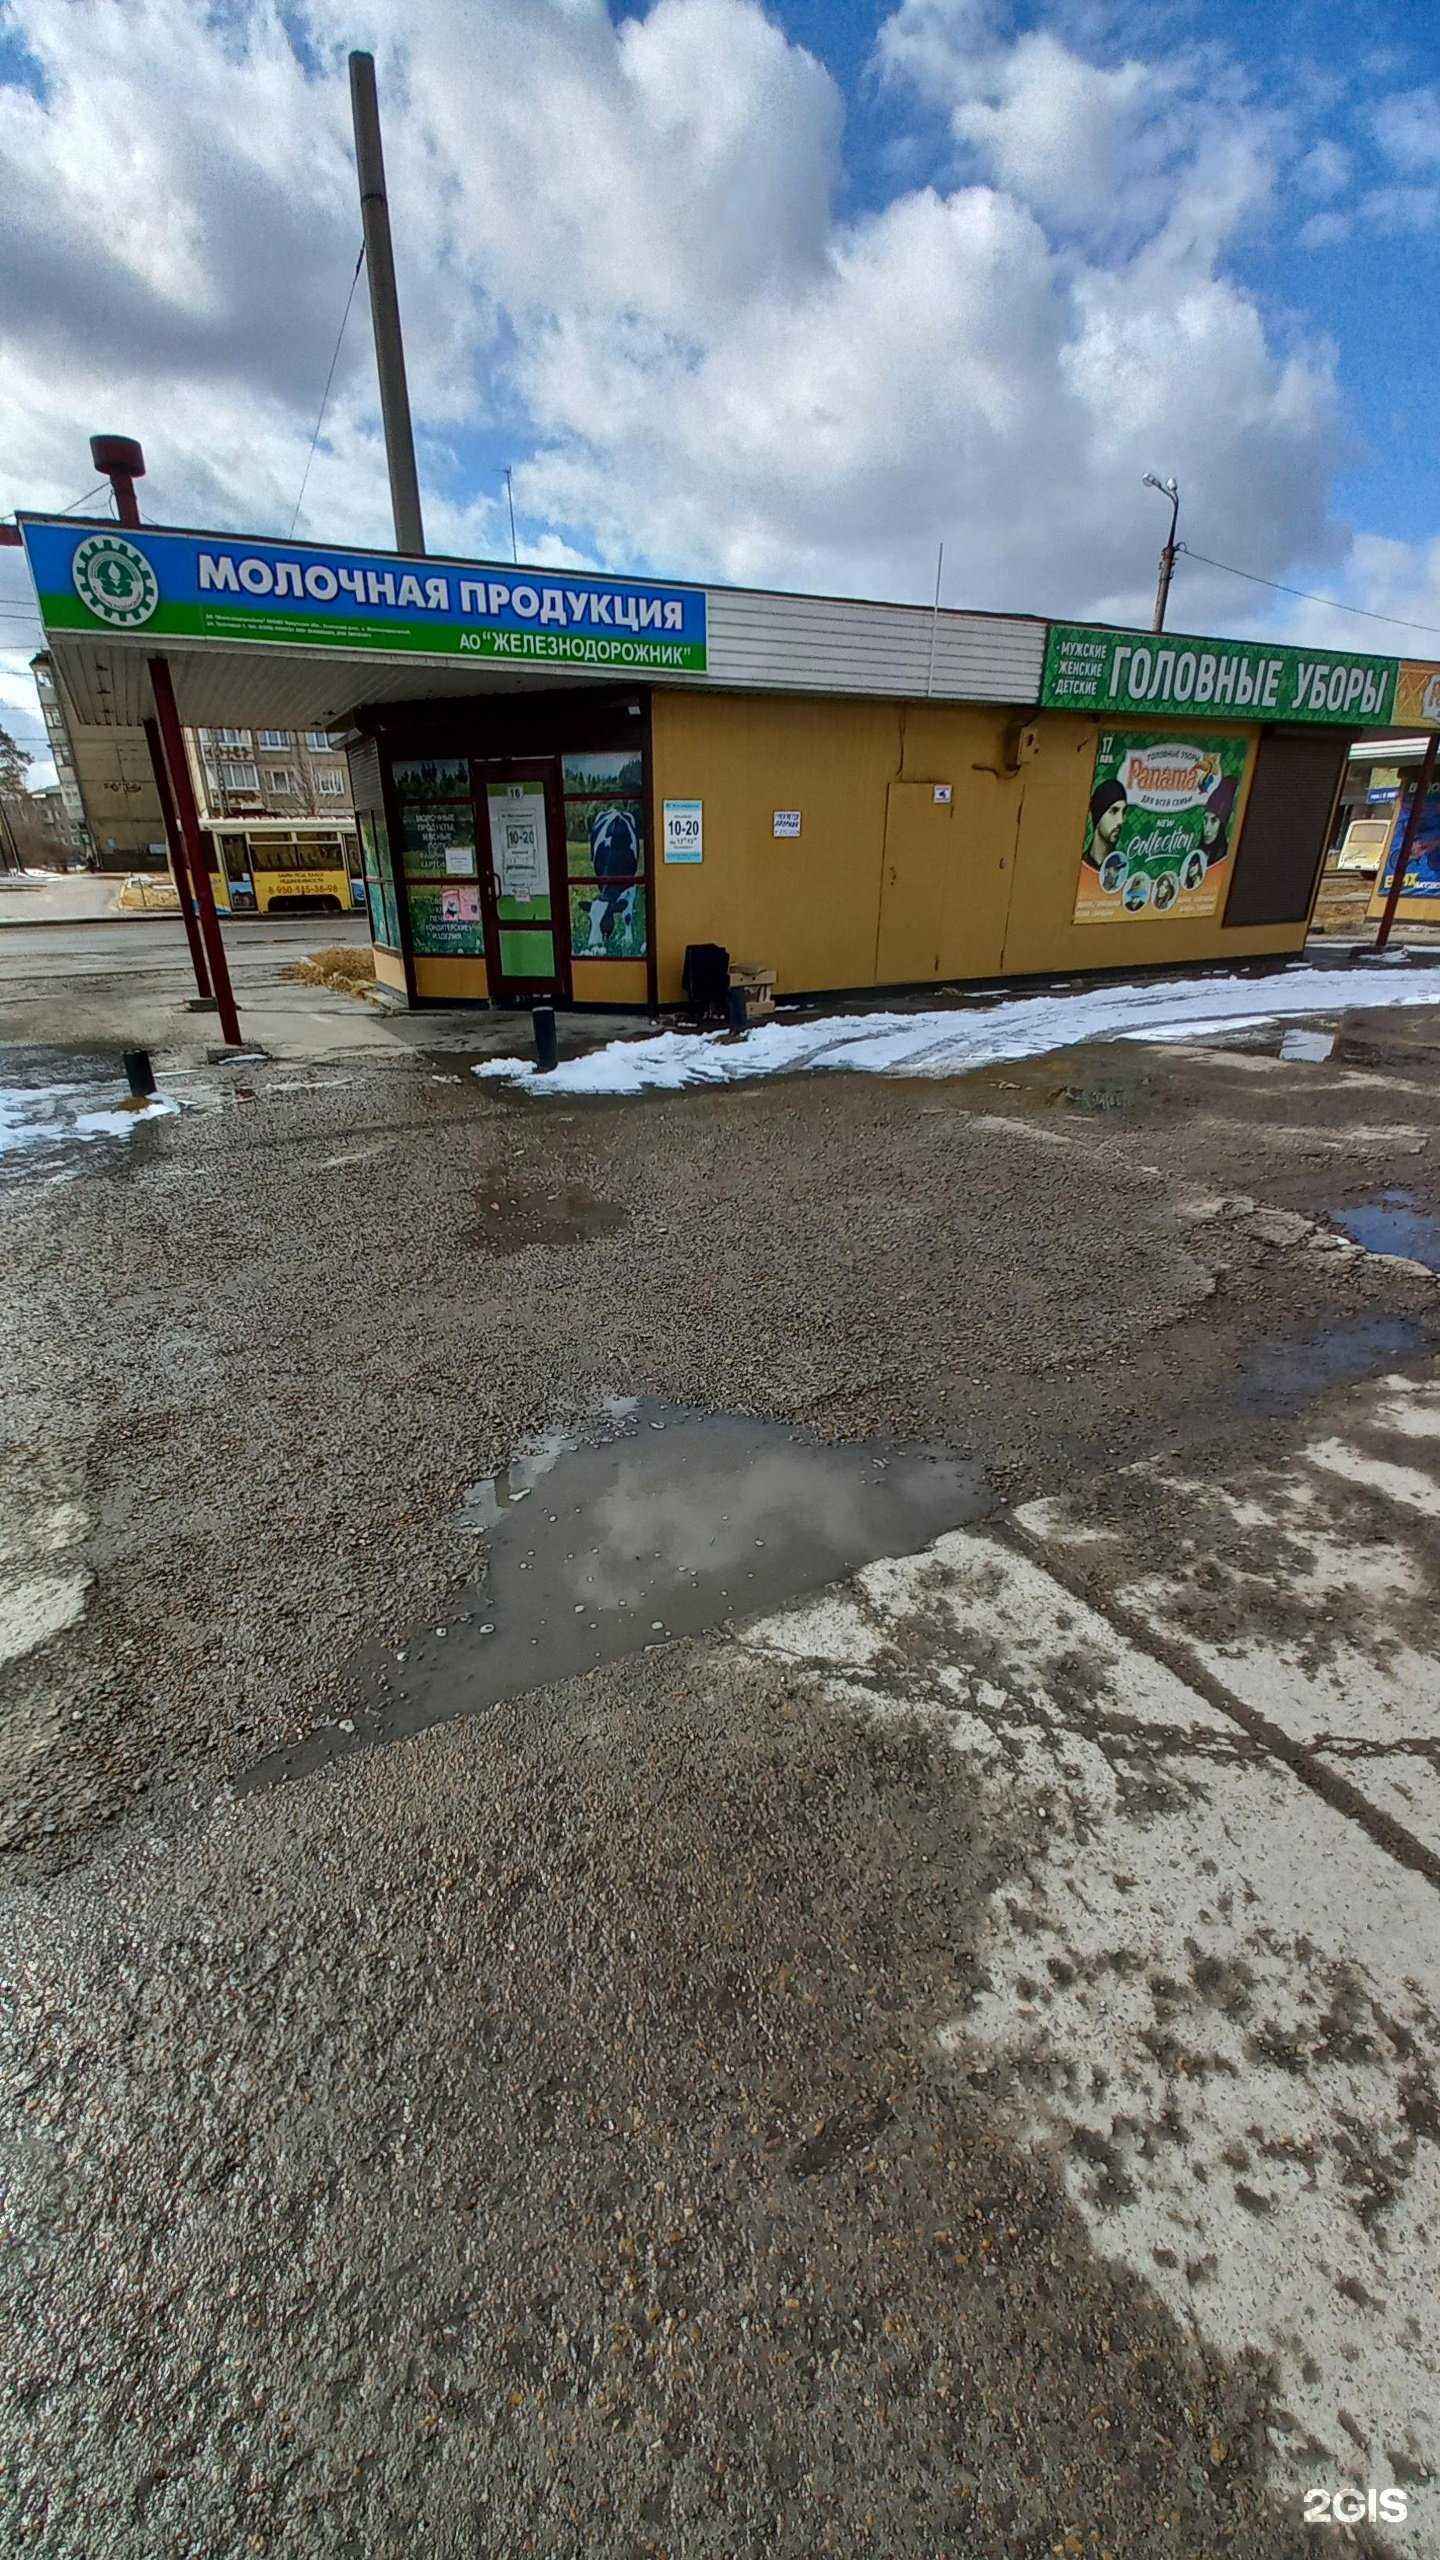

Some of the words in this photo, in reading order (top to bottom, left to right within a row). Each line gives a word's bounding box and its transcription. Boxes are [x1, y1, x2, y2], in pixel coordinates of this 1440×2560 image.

[197, 554, 450, 611] МОЛОЧНАЯ
[459, 580, 683, 633] ПРОДУКЦИЯ
[459, 633, 481, 650] АО
[1060, 642, 1107, 659] МУЖСКИЕ
[1058, 660, 1103, 677] ЖЕНСКИЕ
[1054, 680, 1098, 696] ДЕТСКИЕ
[1108, 646, 1284, 708] ГОЛОВНЫЕ
[1291, 662, 1389, 714] УБОРЫ
[1102, 736, 1114, 754] 17
[668, 820, 699, 836] 10-20
[1156, 819, 1175, 828] NEW
[1126, 826, 1194, 860] Collection
